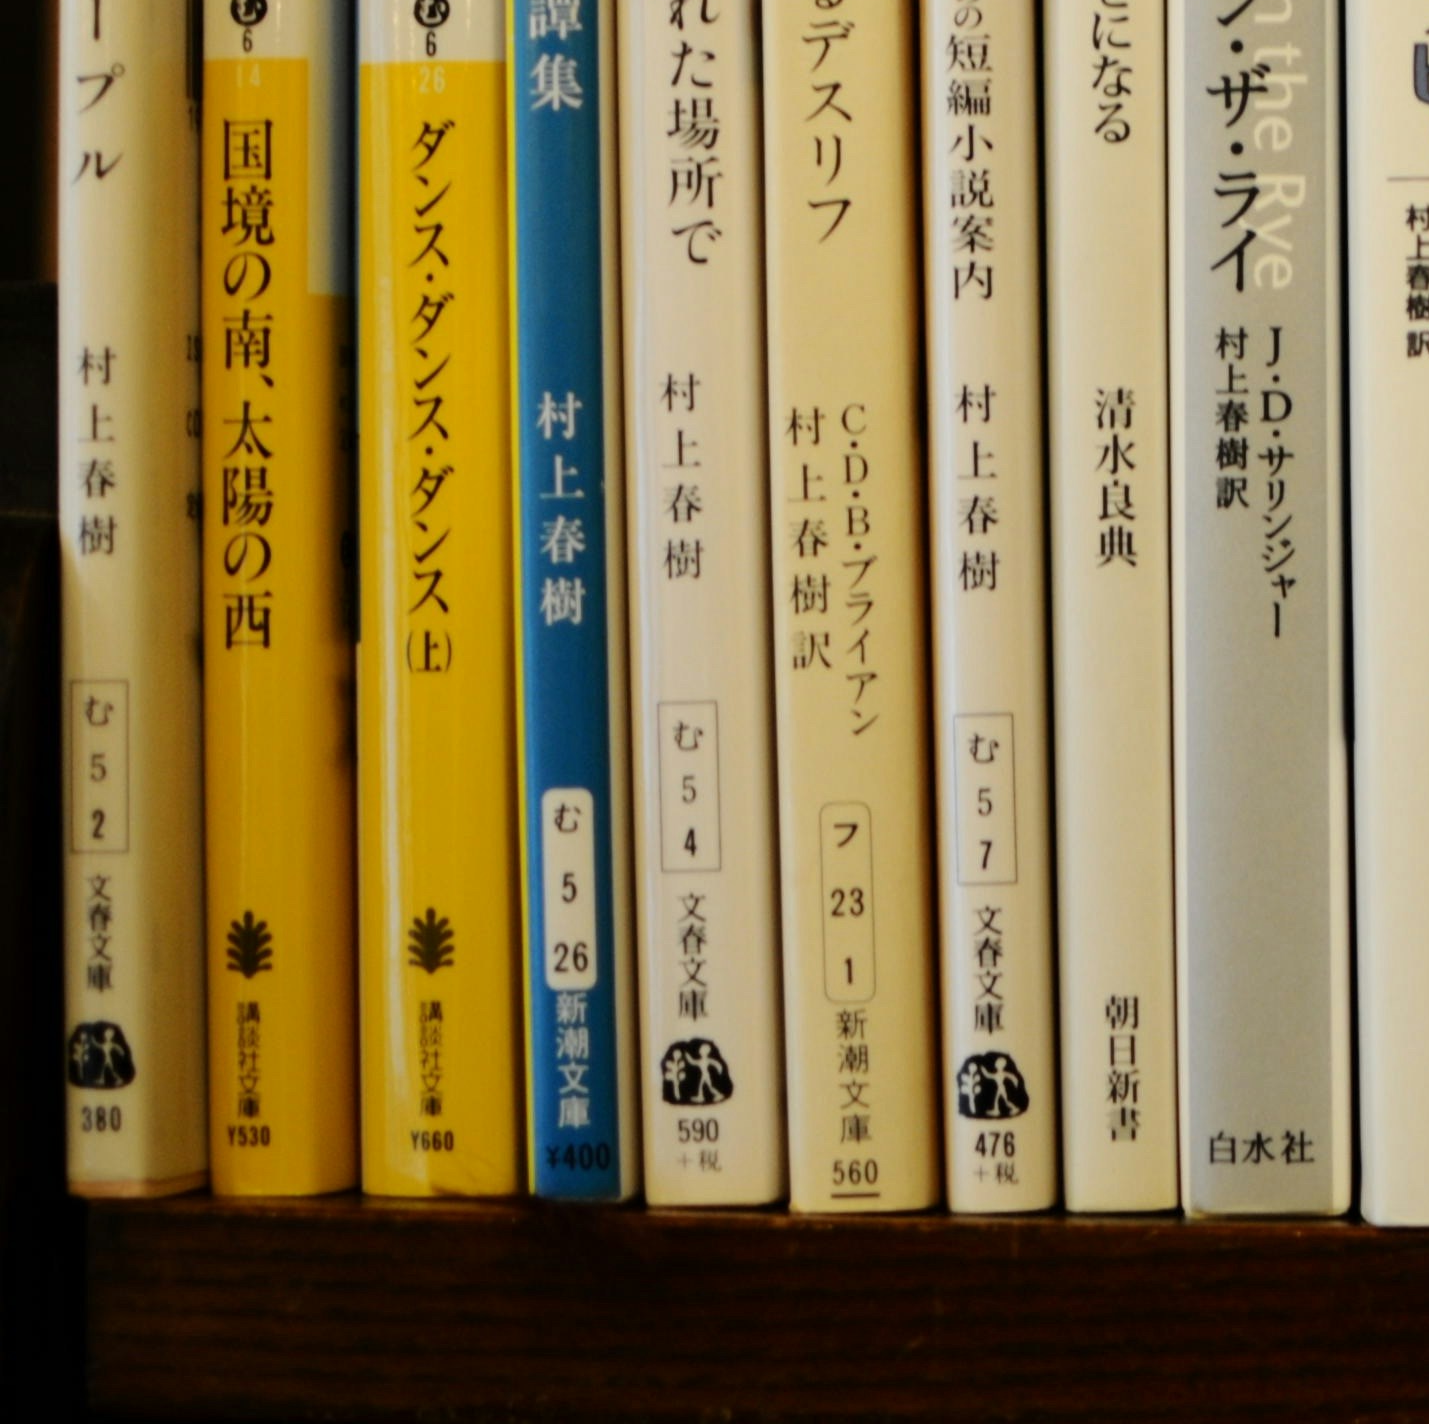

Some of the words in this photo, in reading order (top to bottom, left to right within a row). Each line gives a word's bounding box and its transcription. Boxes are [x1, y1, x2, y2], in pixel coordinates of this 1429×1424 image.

[1253, 42, 1308, 152] the
[219, 117, 276, 650] 国境の南、太陽の西
[78, 346, 118, 556] 村上春樹
[536, 391, 587, 626] 村上春樹
[659, 372, 705, 580] 村上春樹
[954, 384, 1001, 592] 村上春樹
[1094, 386, 1138, 570] 清水良典
[87, 874, 113, 994] 文春文庫
[677, 892, 708, 1023] 文春文庫
[973, 905, 1004, 1036] 文春文庫
[81, 1106, 122, 1132] 380
[556, 991, 591, 1129] 新潮文庫
[835, 1008, 872, 1144] 新潮文庫
[1105, 994, 1140, 1142] 朝日新書
[677, 1118, 720, 1144] 590
[832, 1160, 879, 1185] 560
[975, 1132, 1016, 1159] 476
[1208, 1130, 1315, 1166] 白水社
